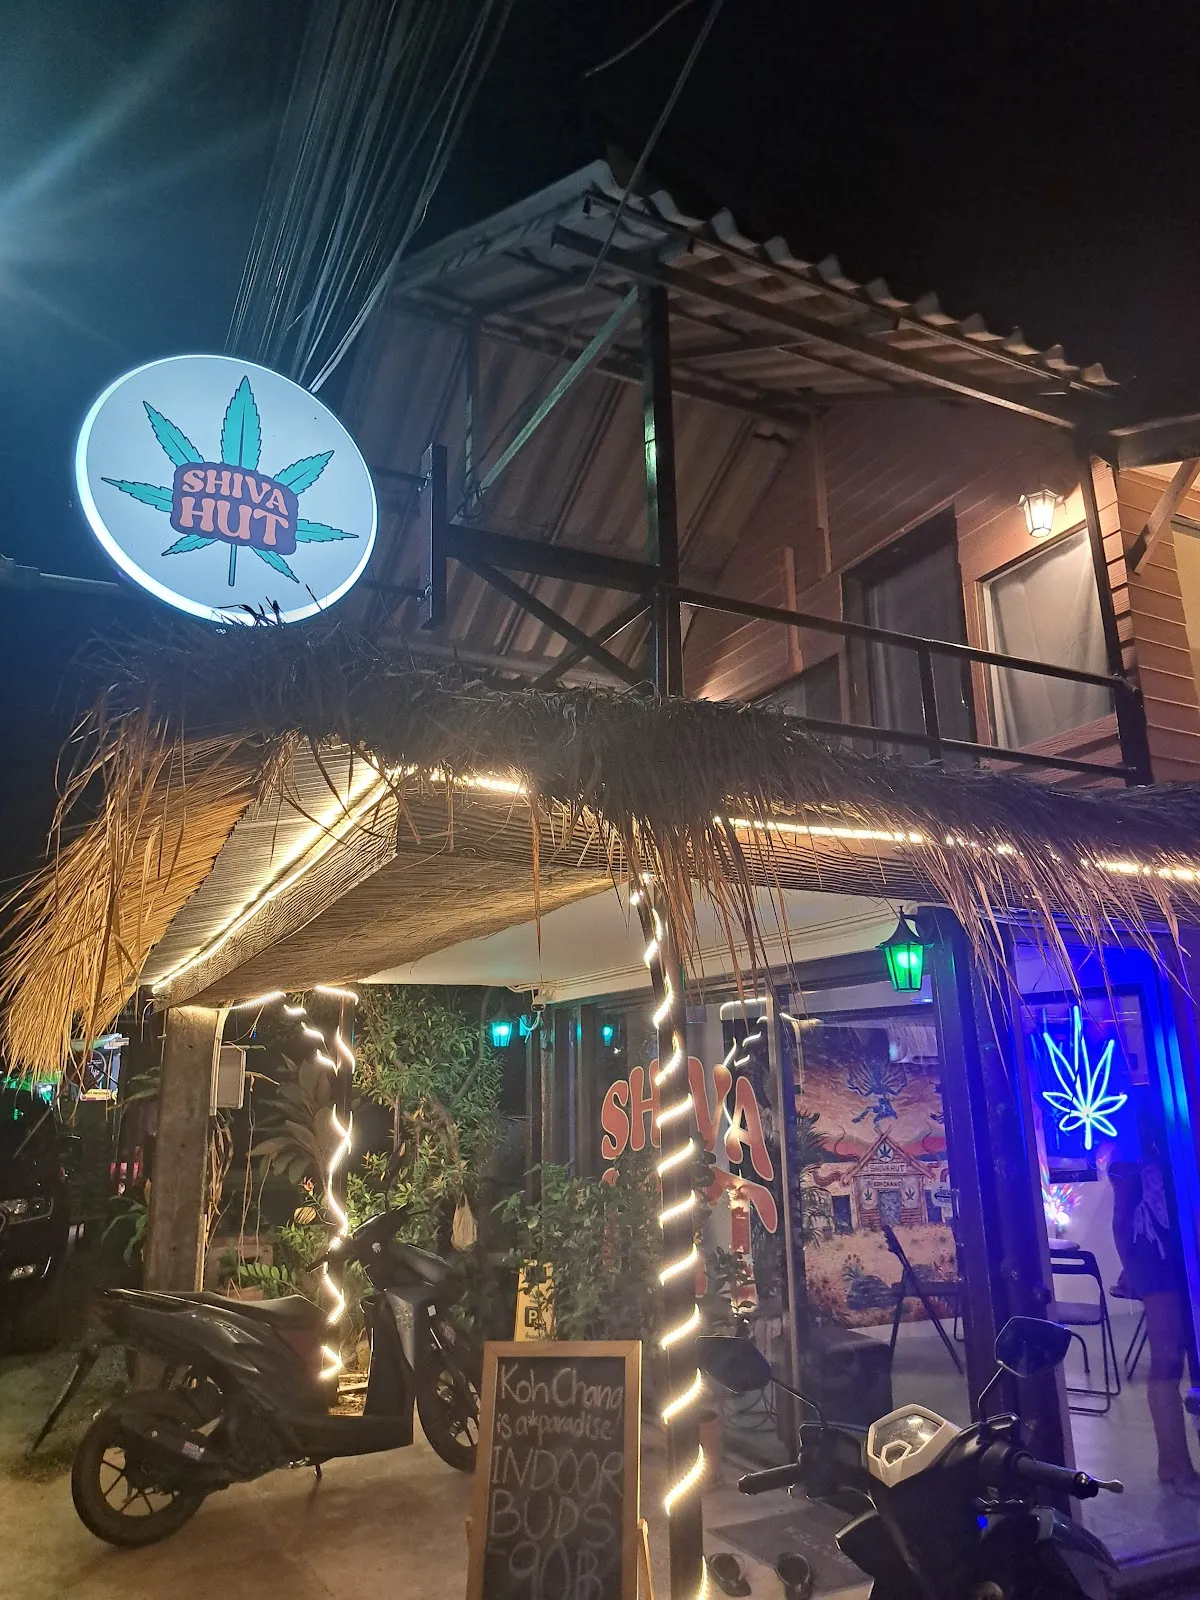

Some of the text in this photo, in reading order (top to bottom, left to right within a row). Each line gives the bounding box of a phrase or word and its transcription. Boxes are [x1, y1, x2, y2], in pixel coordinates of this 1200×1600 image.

[182, 468, 289, 515] SHIVA
[179, 496, 289, 546] HUT
[601, 1056, 774, 1181] SHVA
[501, 1363, 625, 1425] Koh Chang
[496, 1412, 512, 1440] is
[491, 1445, 625, 1498] INDOOR
[490, 1489, 616, 1548] BUDS
